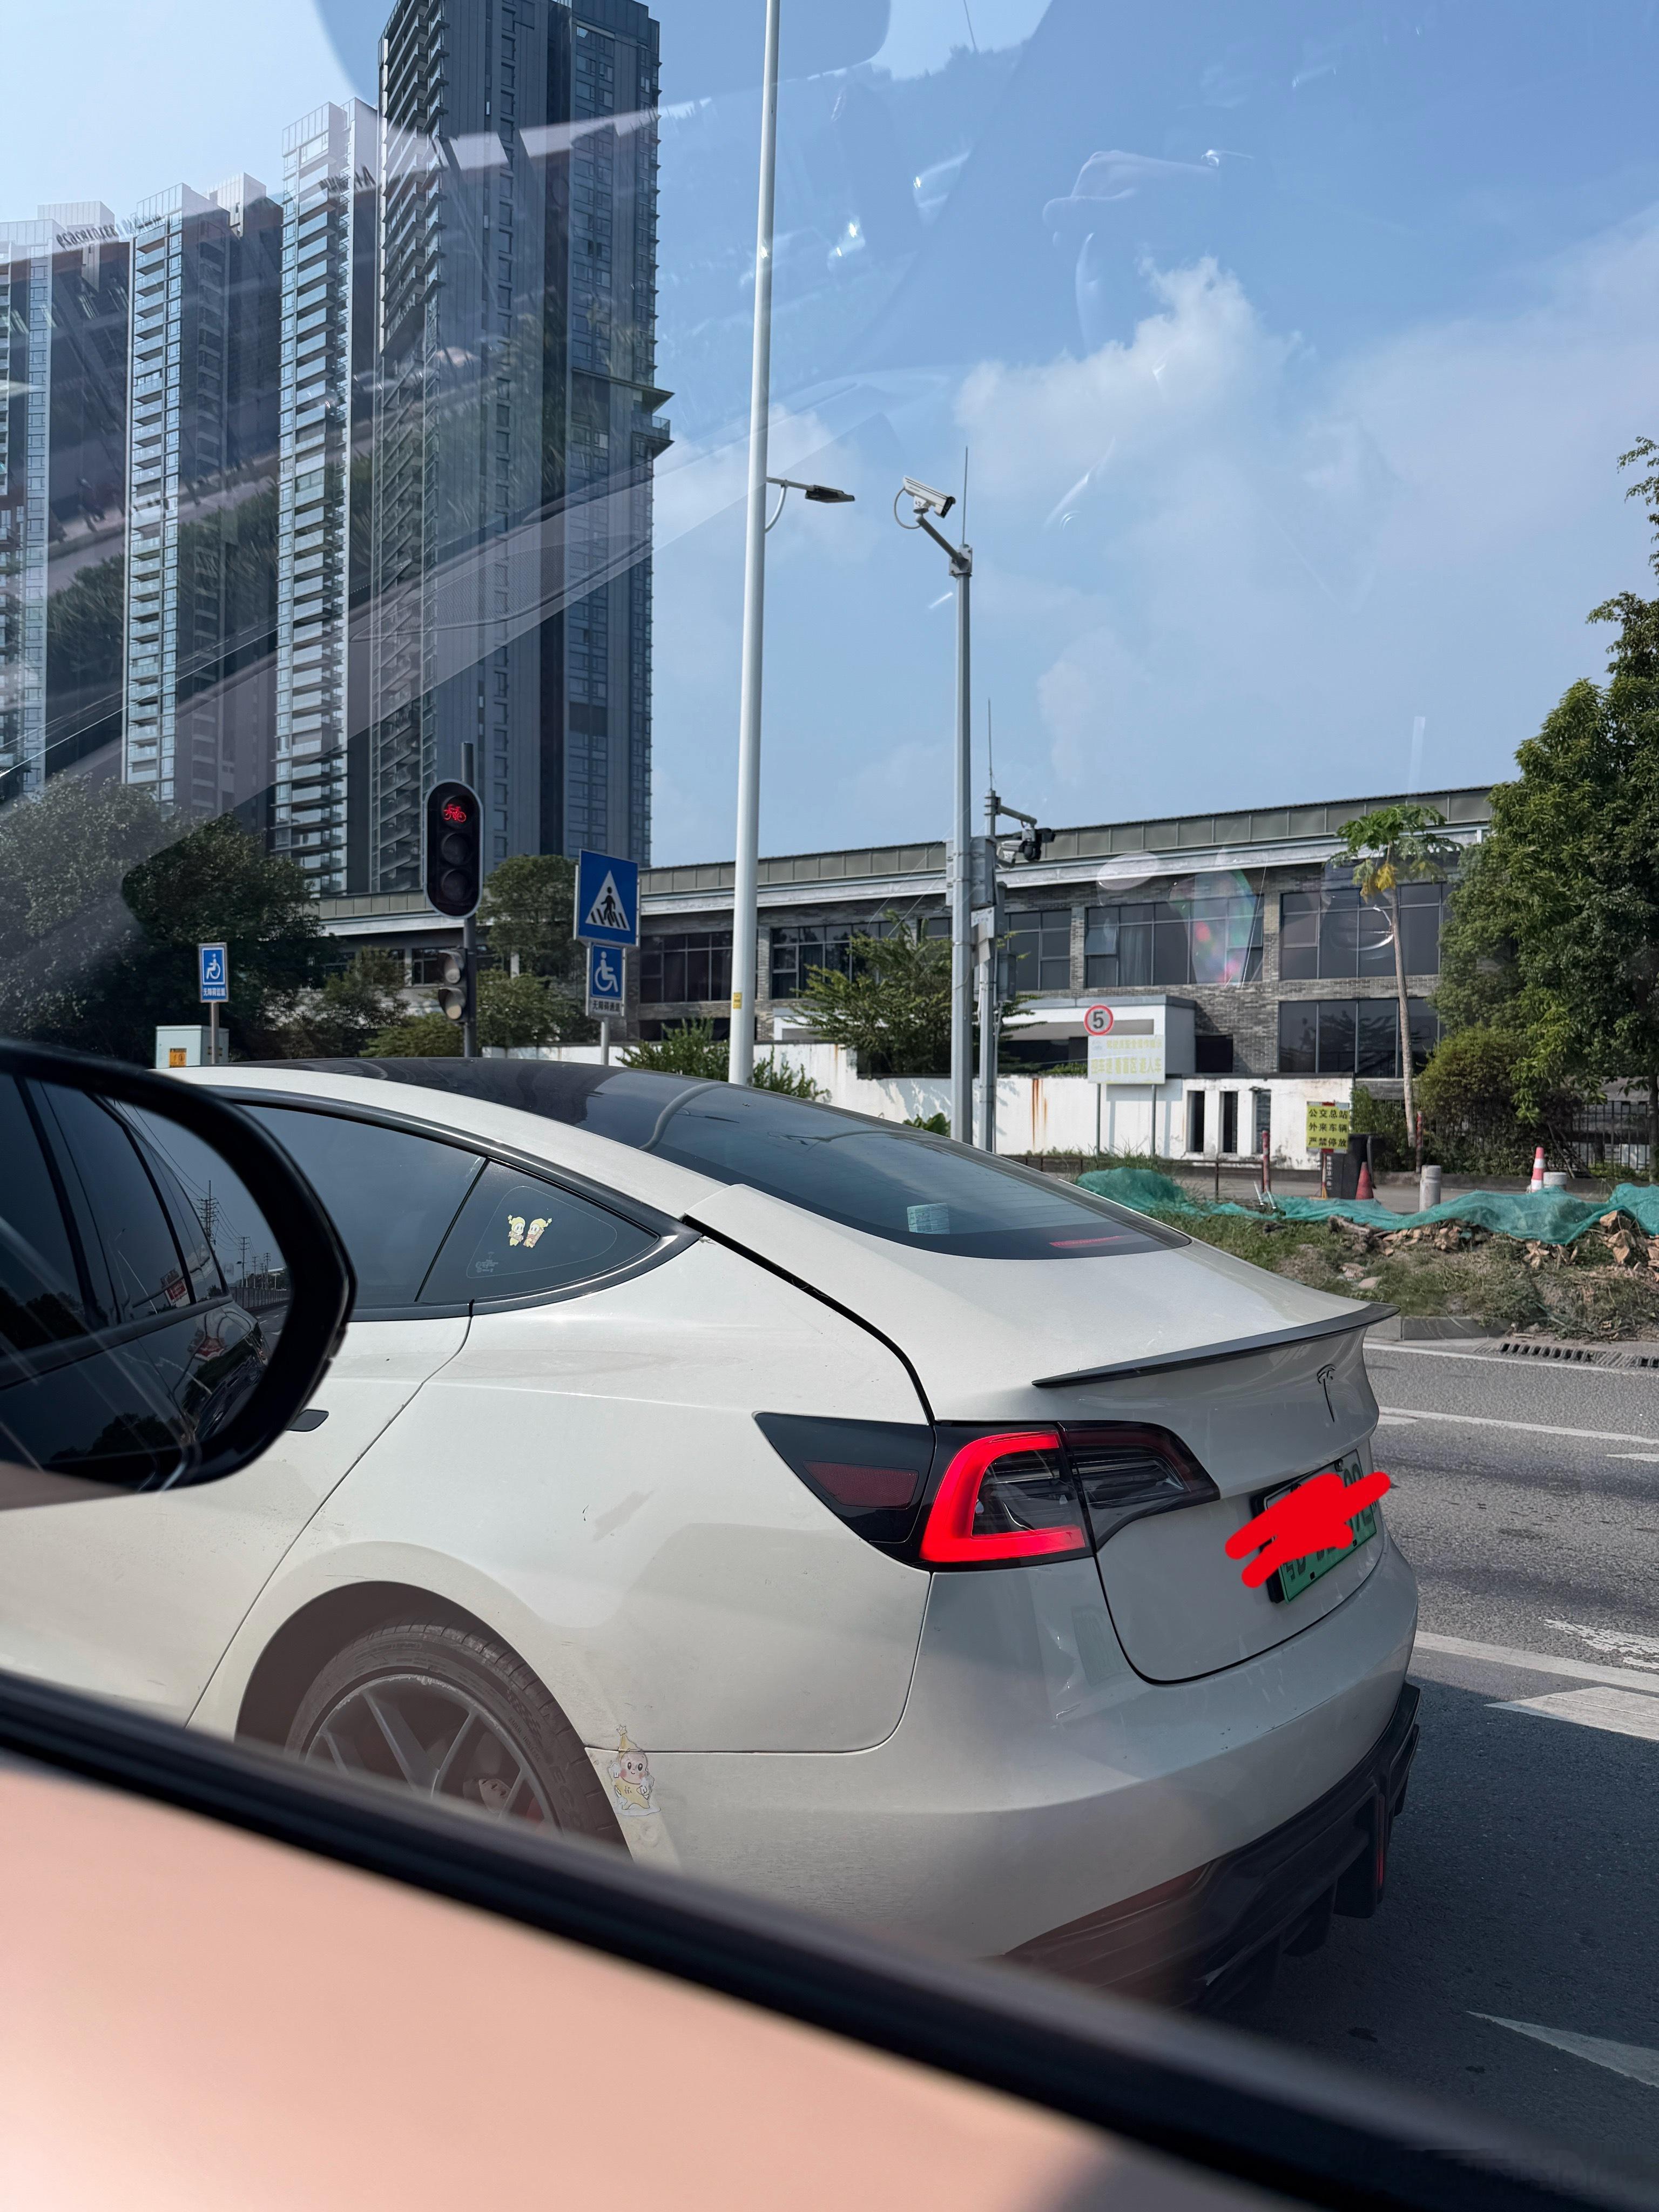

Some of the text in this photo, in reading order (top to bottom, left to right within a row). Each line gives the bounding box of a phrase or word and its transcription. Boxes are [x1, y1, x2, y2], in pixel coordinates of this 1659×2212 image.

[1093, 1011, 1104, 1029] 5
[1309, 1109, 1348, 1120] 公交总站
[1309, 1122, 1347, 1132] 外来车辆
[1309, 1136, 1347, 1148] 严禁停放
